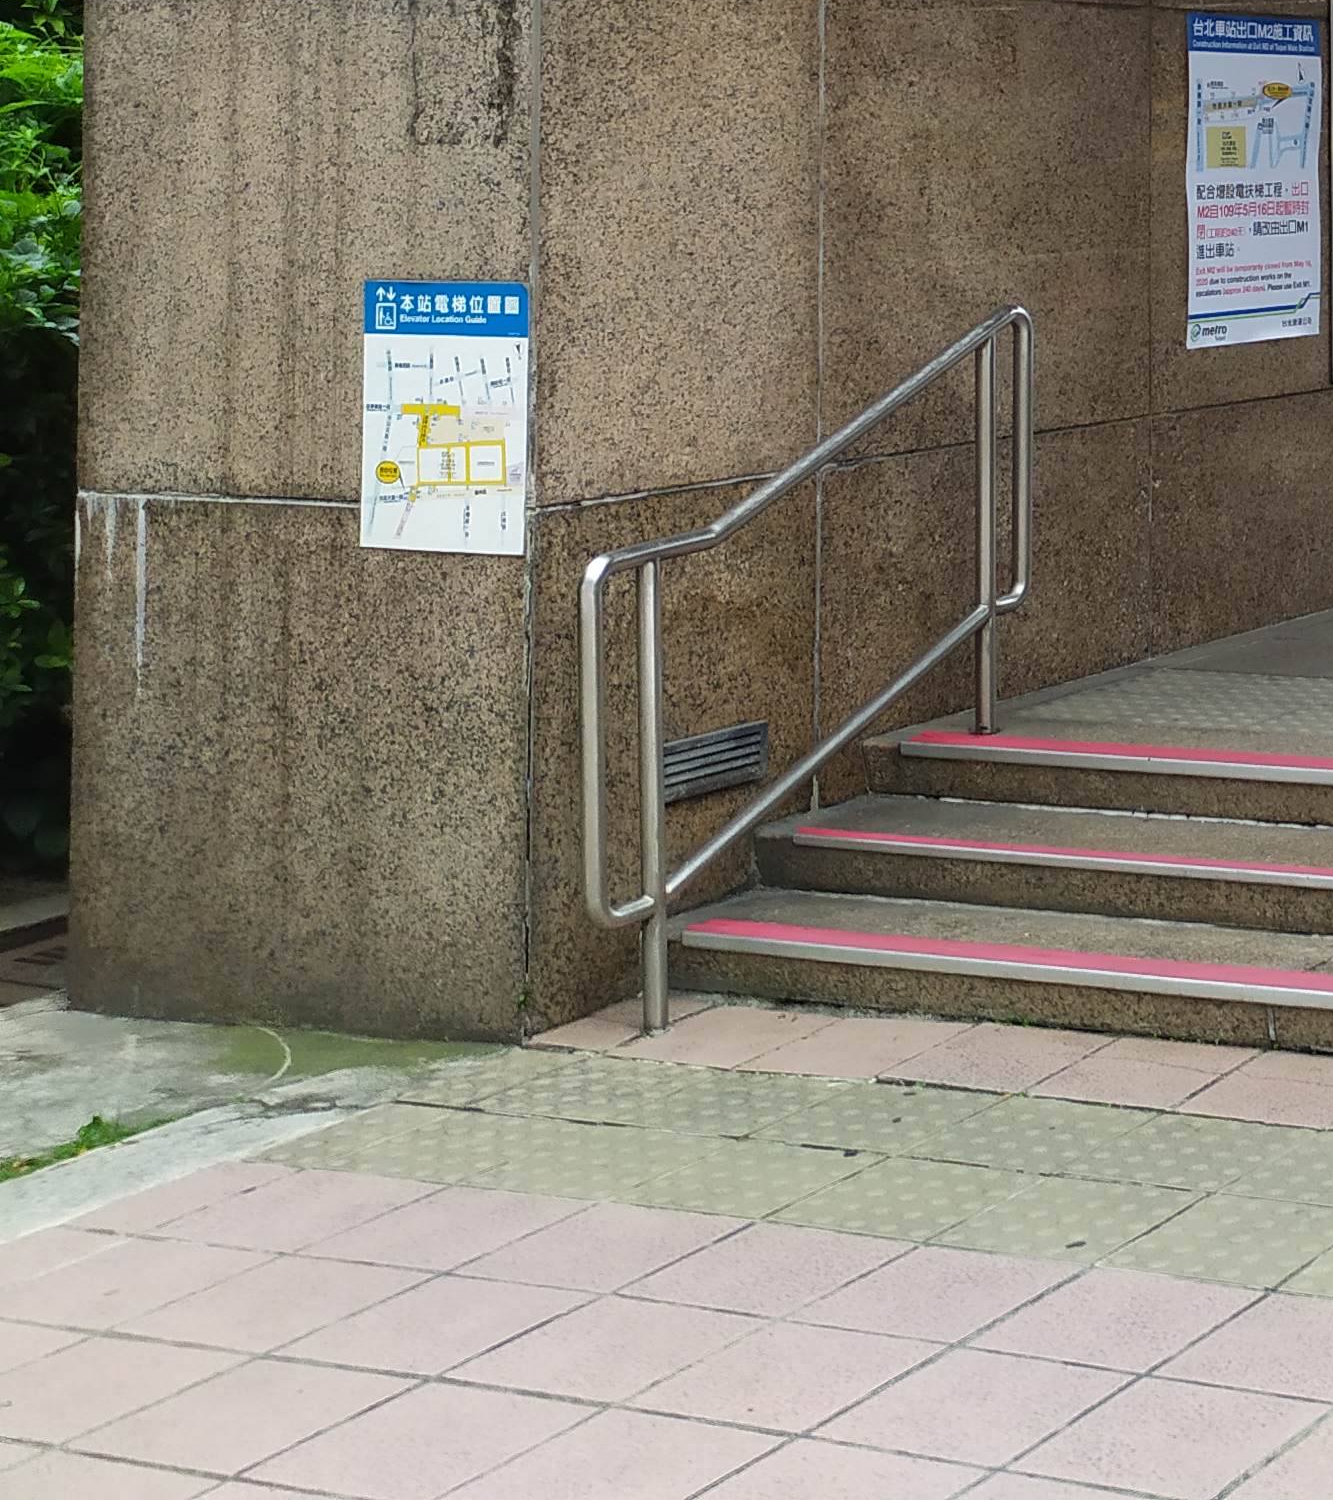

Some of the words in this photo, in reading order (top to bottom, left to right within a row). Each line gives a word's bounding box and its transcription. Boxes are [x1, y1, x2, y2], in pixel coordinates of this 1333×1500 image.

[1192, 17, 1314, 43] 台北車站出口M2施工資訊
[1192, 39, 1221, 48] Construction
[1226, 275, 1260, 284] construction
[1267, 283, 1283, 291] Please
[399, 293, 520, 315] 本站電梯位置圖
[400, 314, 430, 324] Elevator
[431, 315, 464, 324] Location
[464, 316, 488, 324] Guide
[1202, 325, 1227, 336] metro
